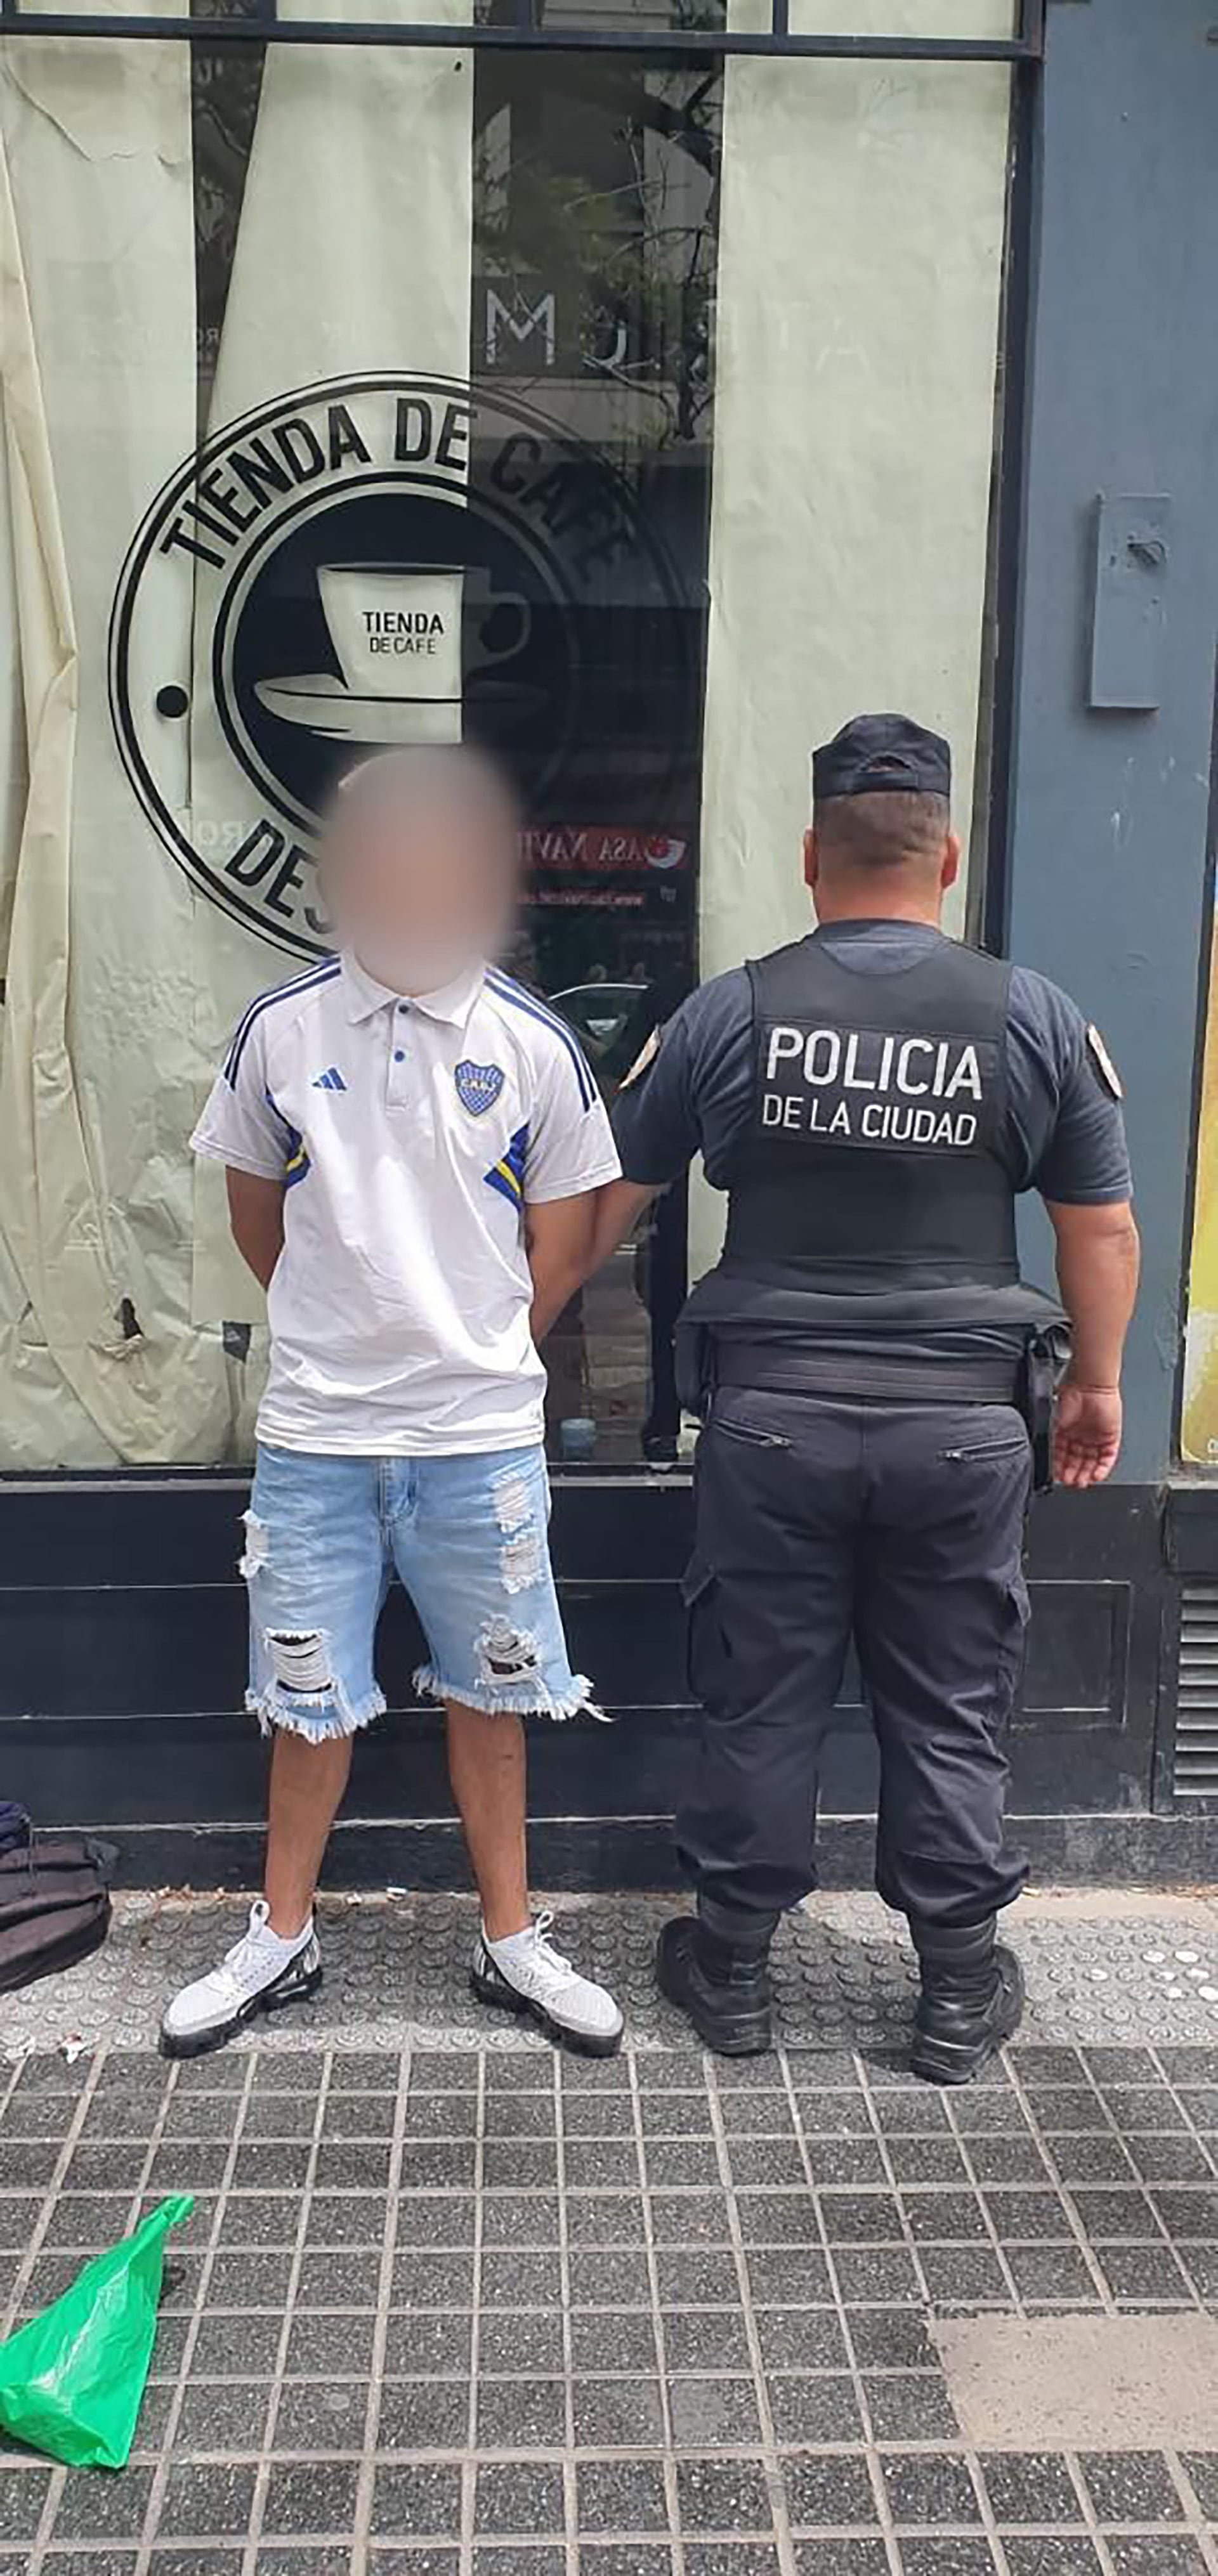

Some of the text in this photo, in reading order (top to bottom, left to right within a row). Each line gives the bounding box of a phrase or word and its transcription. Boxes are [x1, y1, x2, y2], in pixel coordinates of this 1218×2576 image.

[160, 404, 372, 569] TIENDA
[395, 398, 477, 471] DE
[362, 611, 444, 635] TIENDA
[370, 637, 436, 654] DE CAFE
[766, 1027, 983, 1100] POLICIA
[763, 1094, 977, 1146] DE LA CIUDAD
